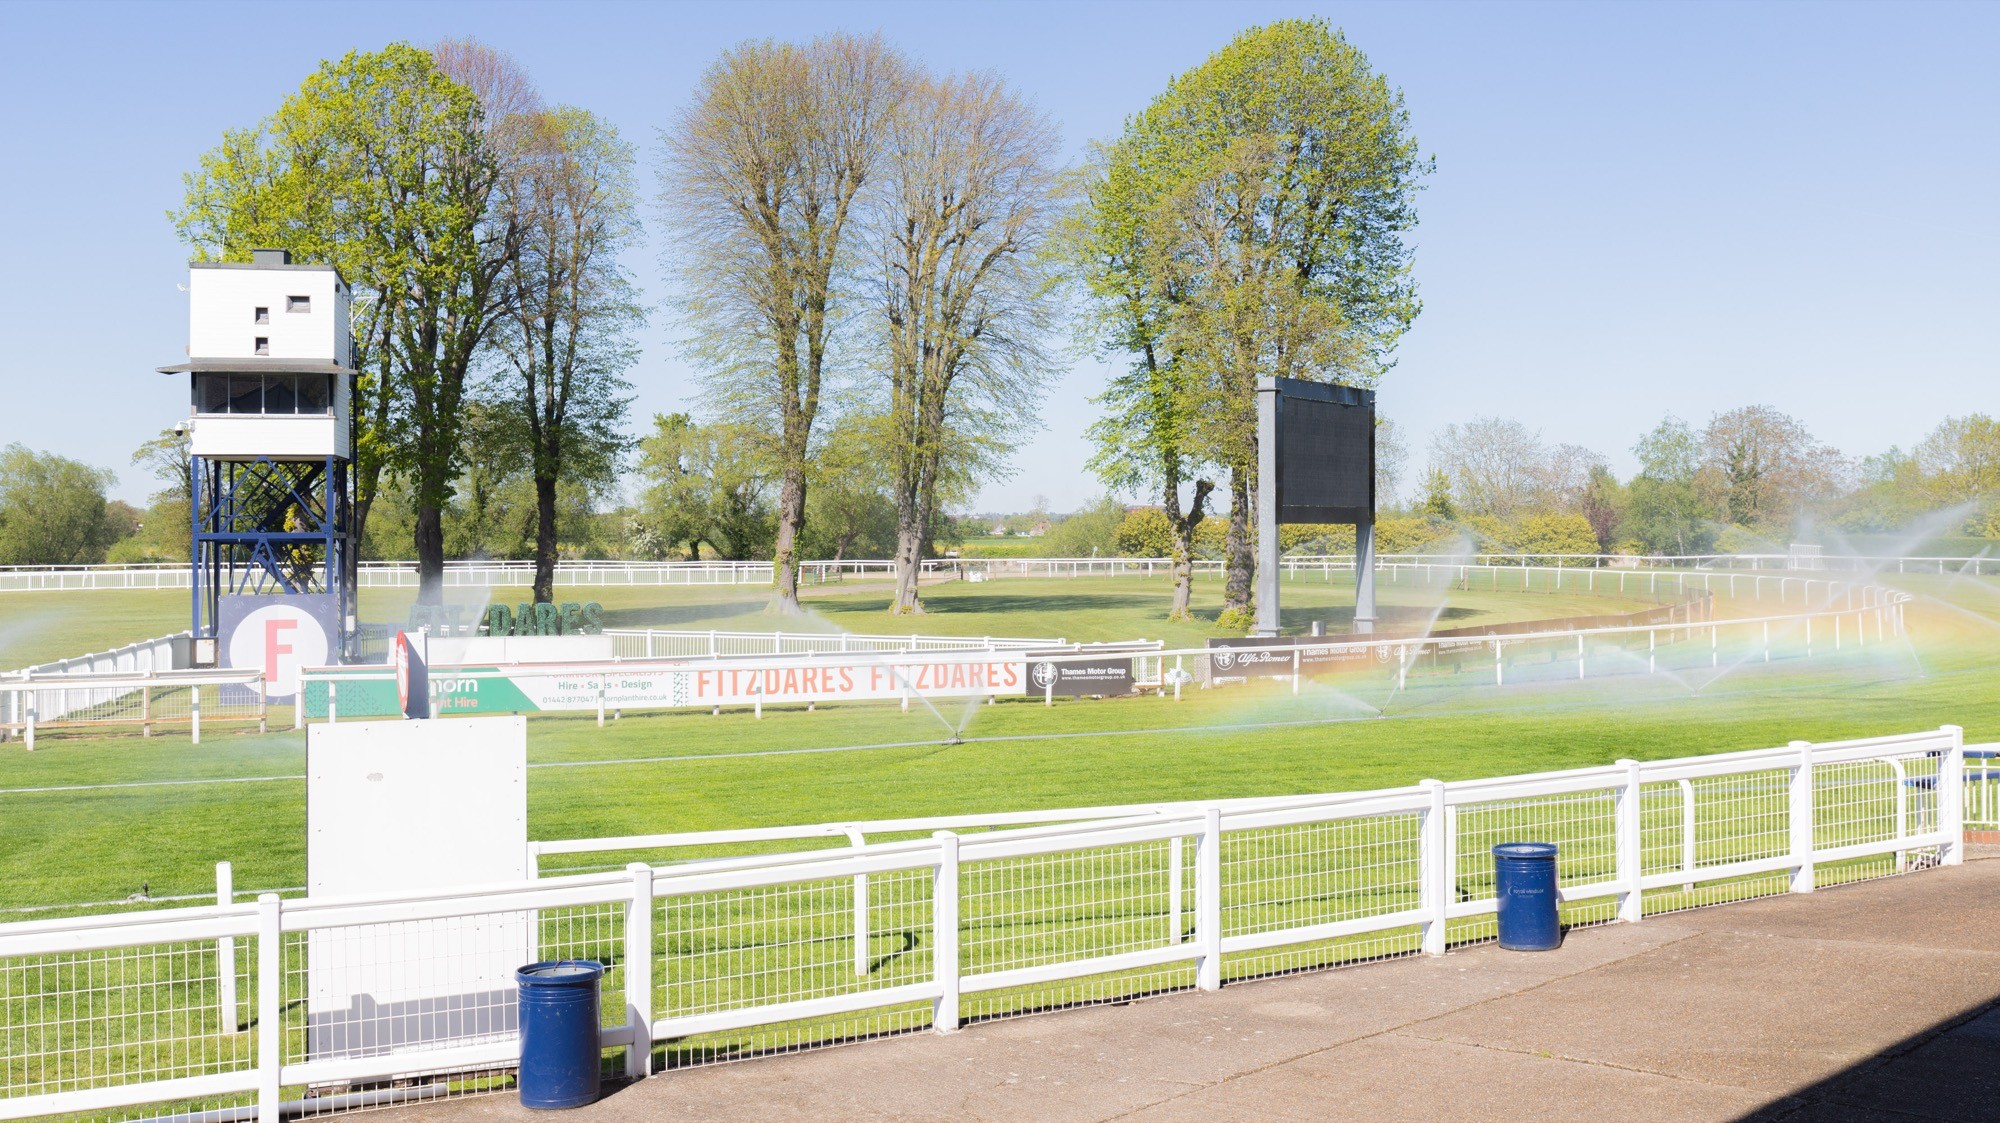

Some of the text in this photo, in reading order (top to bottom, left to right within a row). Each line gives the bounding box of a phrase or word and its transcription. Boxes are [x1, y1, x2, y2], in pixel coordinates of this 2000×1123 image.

[266, 619, 297, 682] F
[1238, 652, 1260, 667] Alfa
[1260, 651, 1291, 663] Romeo
[1107, 667, 1126, 675] Group
[558, 680, 653, 690] Hire Saes Design
[698, 666, 854, 697] FITZDARES
[871, 662, 1017, 691] FIZDARES
[454, 696, 478, 708] Hire
[542, 696, 565, 704] 01442
[567, 695, 594, 703] 877047
